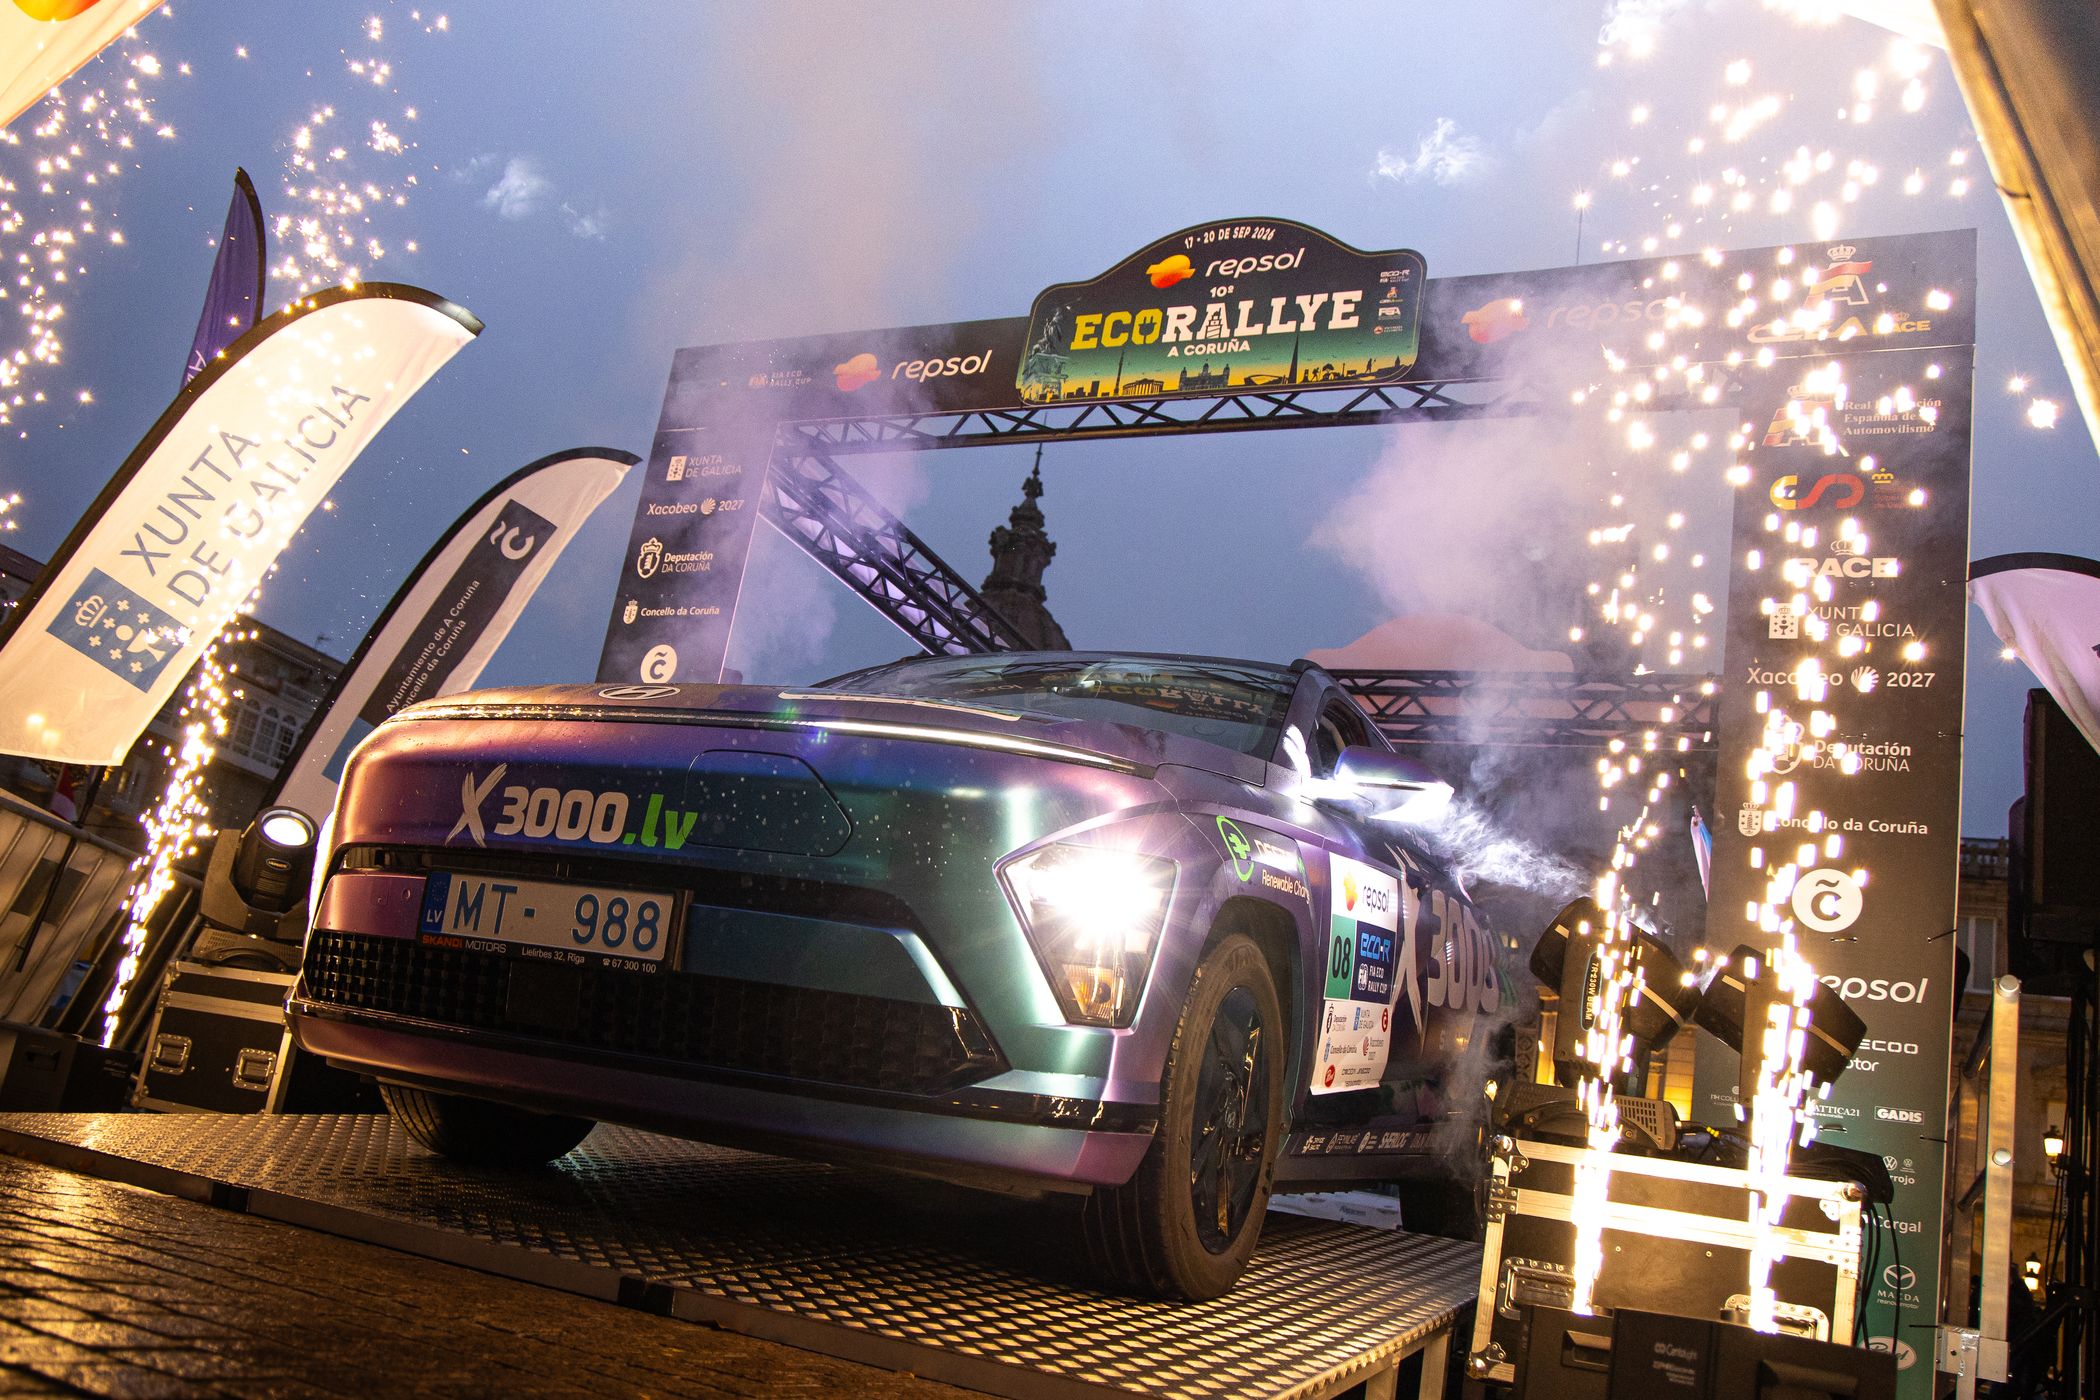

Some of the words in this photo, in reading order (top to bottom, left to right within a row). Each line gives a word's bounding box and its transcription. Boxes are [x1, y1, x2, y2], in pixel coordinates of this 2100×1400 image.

[1184, 236, 1194, 250] 17
[1203, 230, 1216, 245] 20
[1218, 227, 1231, 241] DE
[1232, 225, 1252, 240] SEP
[1251, 226, 1277, 241] 2026
[1204, 247, 1306, 280] repsol
[1167, 344, 1180, 358] A
[1184, 338, 1251, 357] CORUÑA
[892, 349, 993, 383] repsol
[1844, 400, 1871, 411] Real
[223, 384, 372, 540] GALICIA
[689, 454, 723, 467] XUNTA
[685, 467, 700, 479] DE
[701, 464, 743, 477] GALICIA
[120, 429, 261, 577] XUNTA
[647, 502, 698, 516] Xacobeo
[718, 499, 745, 512] 2027
[664, 551, 714, 564] Deputación
[166, 538, 234, 608] DE
[661, 563, 673, 573] DA
[675, 561, 711, 573] CORUÑA
[641, 607, 676, 617] Concello
[676, 606, 688, 617] da
[690, 605, 720, 617] Coruña
[1807, 606, 1875, 621] XUNT
[1836, 623, 1916, 637] GALICIA
[386, 641, 436, 714] Ayuntamiento
[434, 627, 446, 642] de
[443, 617, 453, 629] A
[450, 579, 481, 617] Coruña
[398, 673, 429, 712] oncello
[427, 659, 439, 672] da
[436, 620, 467, 658] Coruña
[1746, 667, 1844, 686] Xacoeo
[1886, 671, 1936, 688] 2027
[1814, 740, 1912, 758] Deutación
[1812, 755, 1836, 769] DA
[1841, 756, 1911, 772] ORUÑA
[1843, 818, 1863, 831] da
[1868, 819, 1928, 834] Coruña
[1262, 869, 1294, 894] Renewable
[1362, 885, 1390, 913] repsol
[426, 909, 444, 924] LV
[571, 893, 661, 952] 988
[465, 941, 508, 954] MOTORS
[611, 958, 623, 969] 67
[624, 960, 640, 971] 300
[641, 962, 657, 974] 100
[1331, 935, 1352, 980] 08
[1876, 1108, 1923, 1123] GADIS
[1877, 1290, 1920, 1303] MADA
